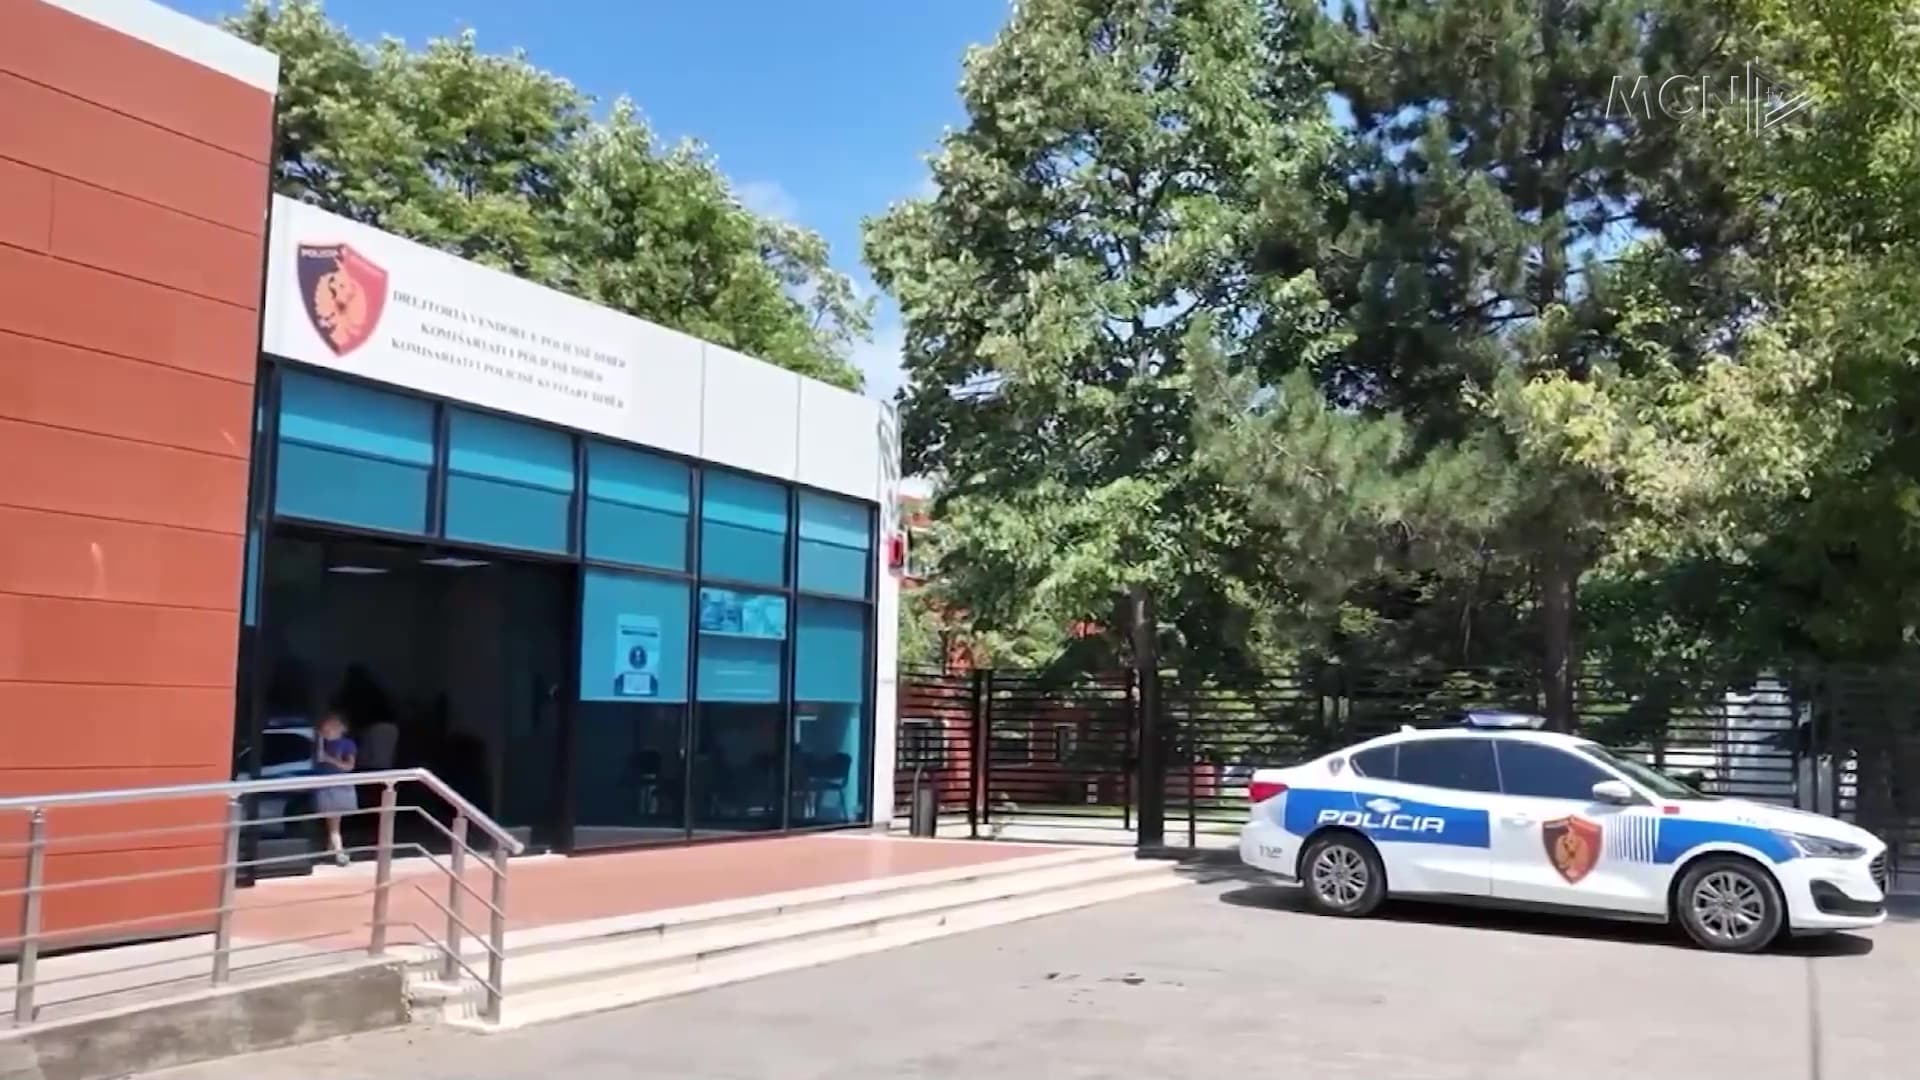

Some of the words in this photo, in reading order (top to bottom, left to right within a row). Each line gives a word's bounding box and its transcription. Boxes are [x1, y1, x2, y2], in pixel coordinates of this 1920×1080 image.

[393, 290, 468, 322] DREJTORIA
[470, 314, 525, 339] VENDORE
[391, 337, 474, 368] KOMISARIATI
[421, 322, 506, 355] KOMISARIATI
[1317, 809, 1446, 833] POLICIA
